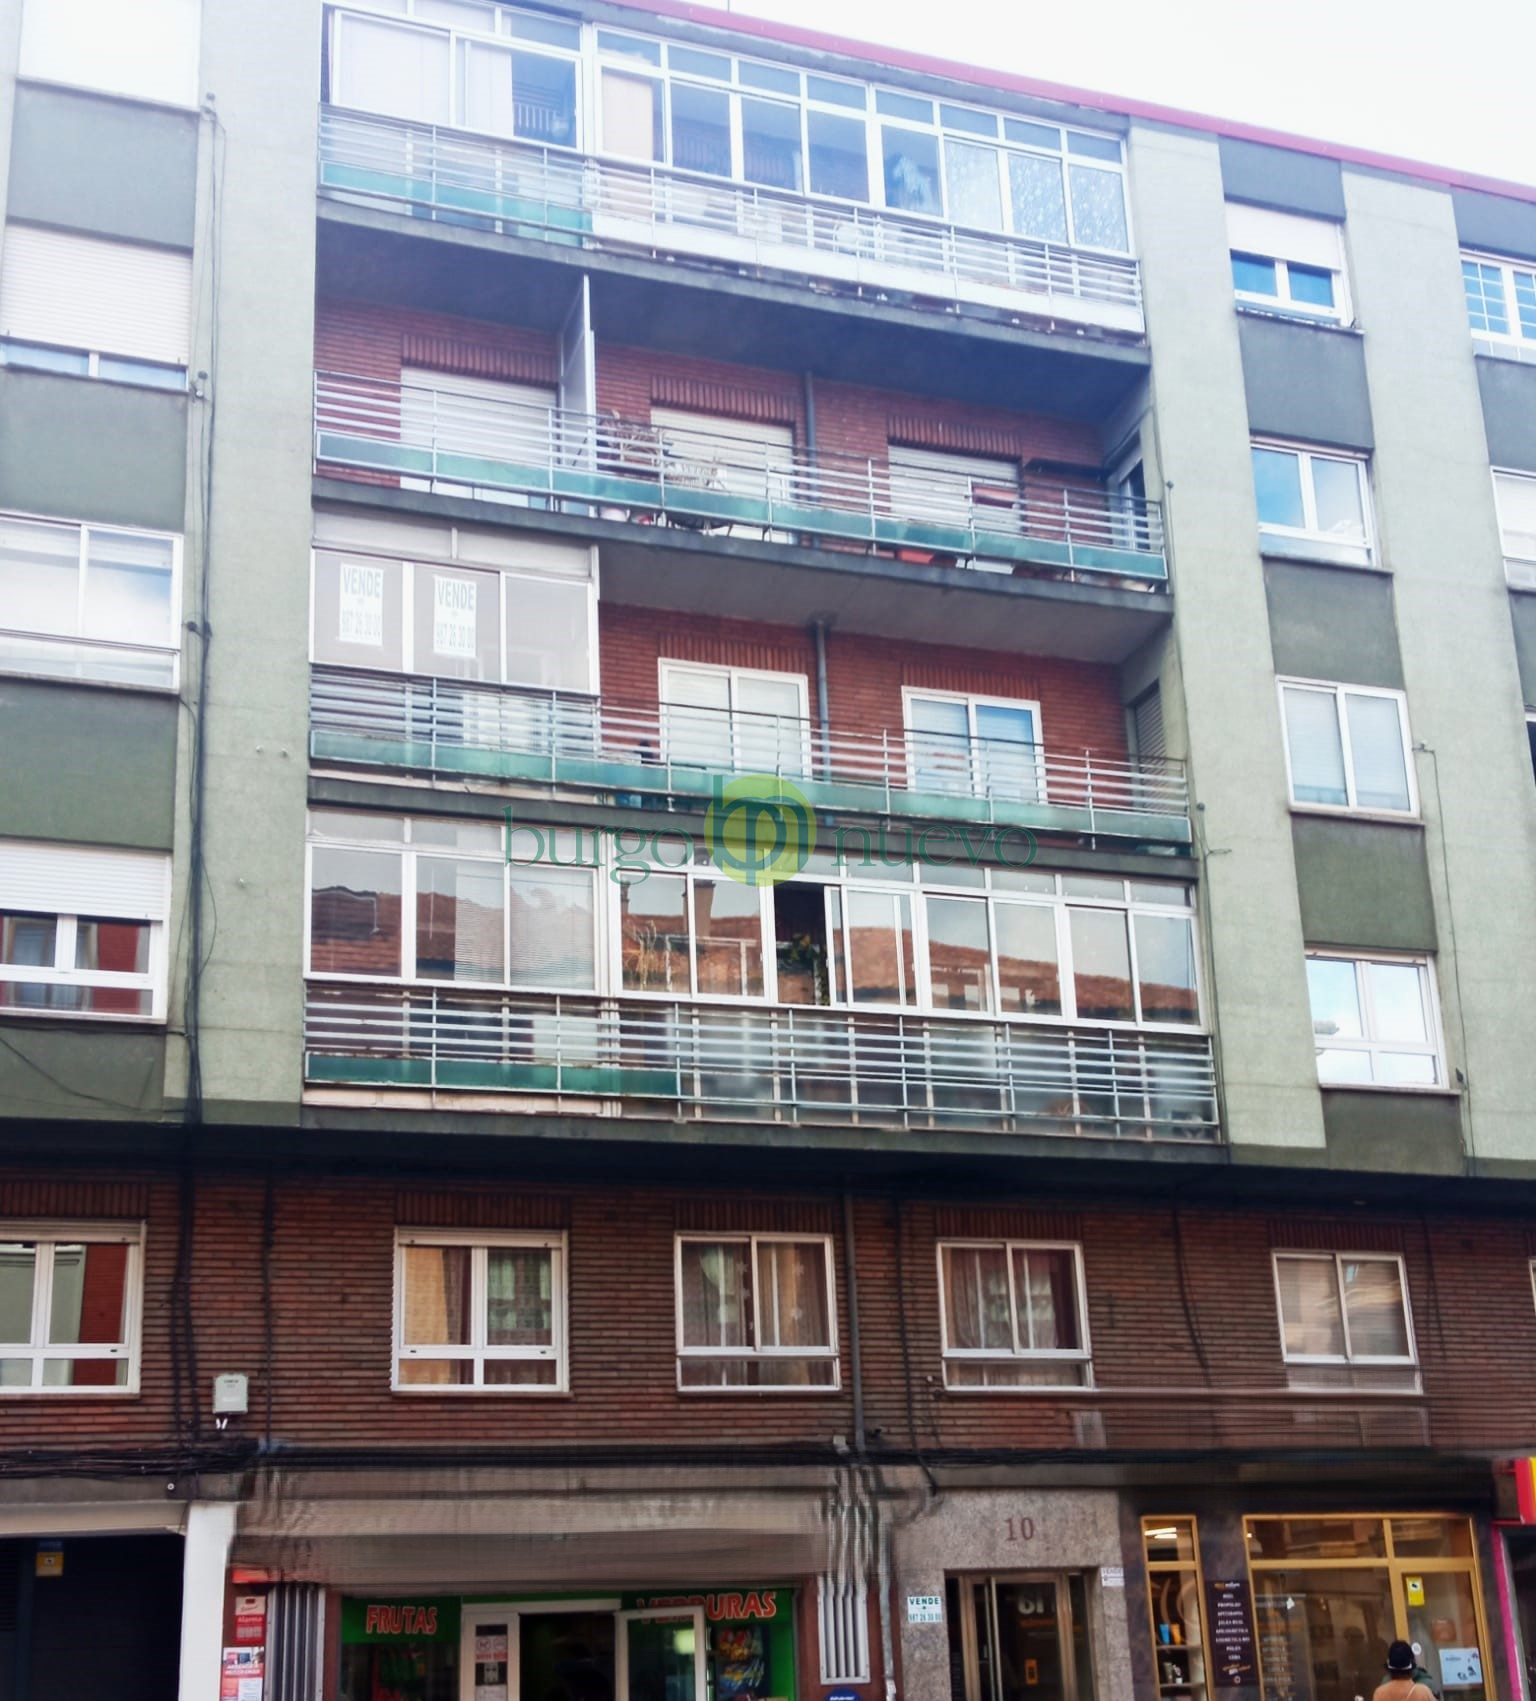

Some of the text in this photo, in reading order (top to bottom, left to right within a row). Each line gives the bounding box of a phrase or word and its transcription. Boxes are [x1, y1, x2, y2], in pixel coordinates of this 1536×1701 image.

[343, 567, 381, 598] VENDE
[437, 580, 475, 611] VENDE
[1005, 1516, 1035, 1541] 10
[909, 1597, 940, 1605] VENDE
[366, 1605, 437, 1636] FRUTAS
